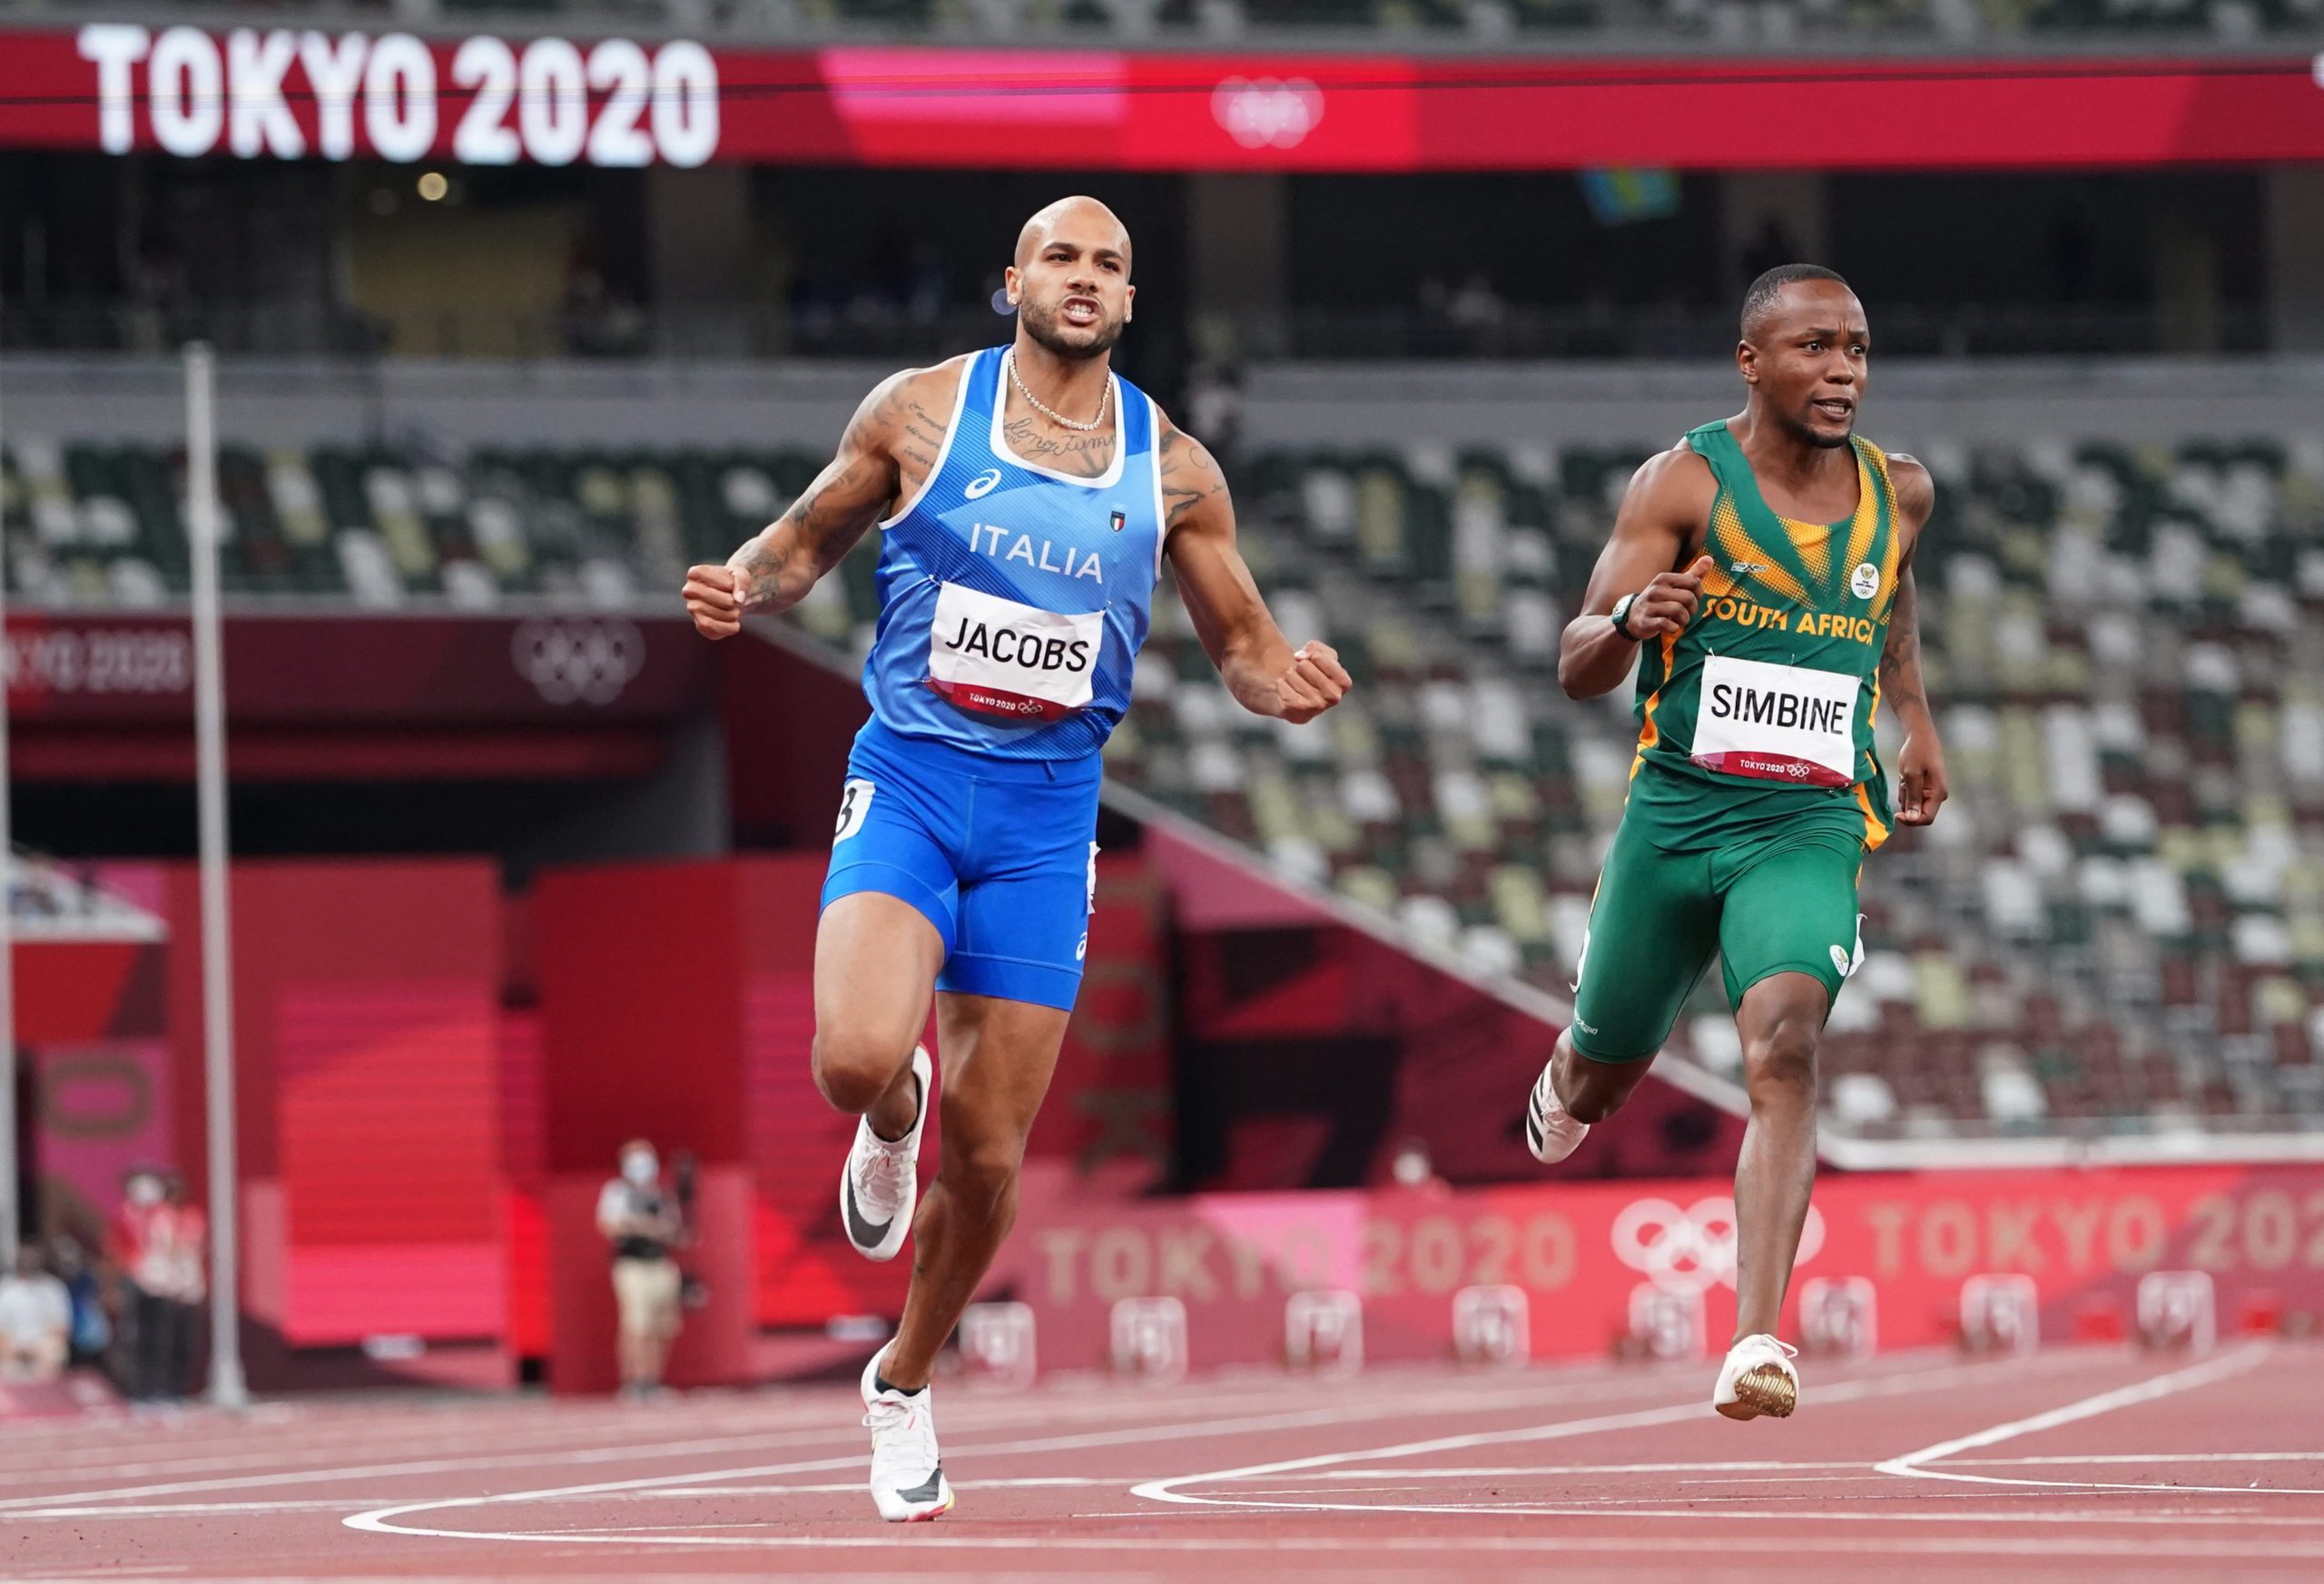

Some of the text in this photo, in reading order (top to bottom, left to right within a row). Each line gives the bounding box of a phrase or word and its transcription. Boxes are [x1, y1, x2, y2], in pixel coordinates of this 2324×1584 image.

[76, 22, 721, 169] TOKYO 2020
[970, 523, 1102, 585] ITALIA
[1702, 597, 1788, 631] SOUTH
[945, 617, 1089, 673] JACOBS
[970, 693, 1016, 711] TOKYO 2020
[1711, 684, 1847, 735] SIMBINE
[1740, 760, 1786, 773] TOKYO 2020
[1033, 1213, 1578, 1305] TOKYO 2020
[1857, 1195, 2166, 1283] TOKYO
